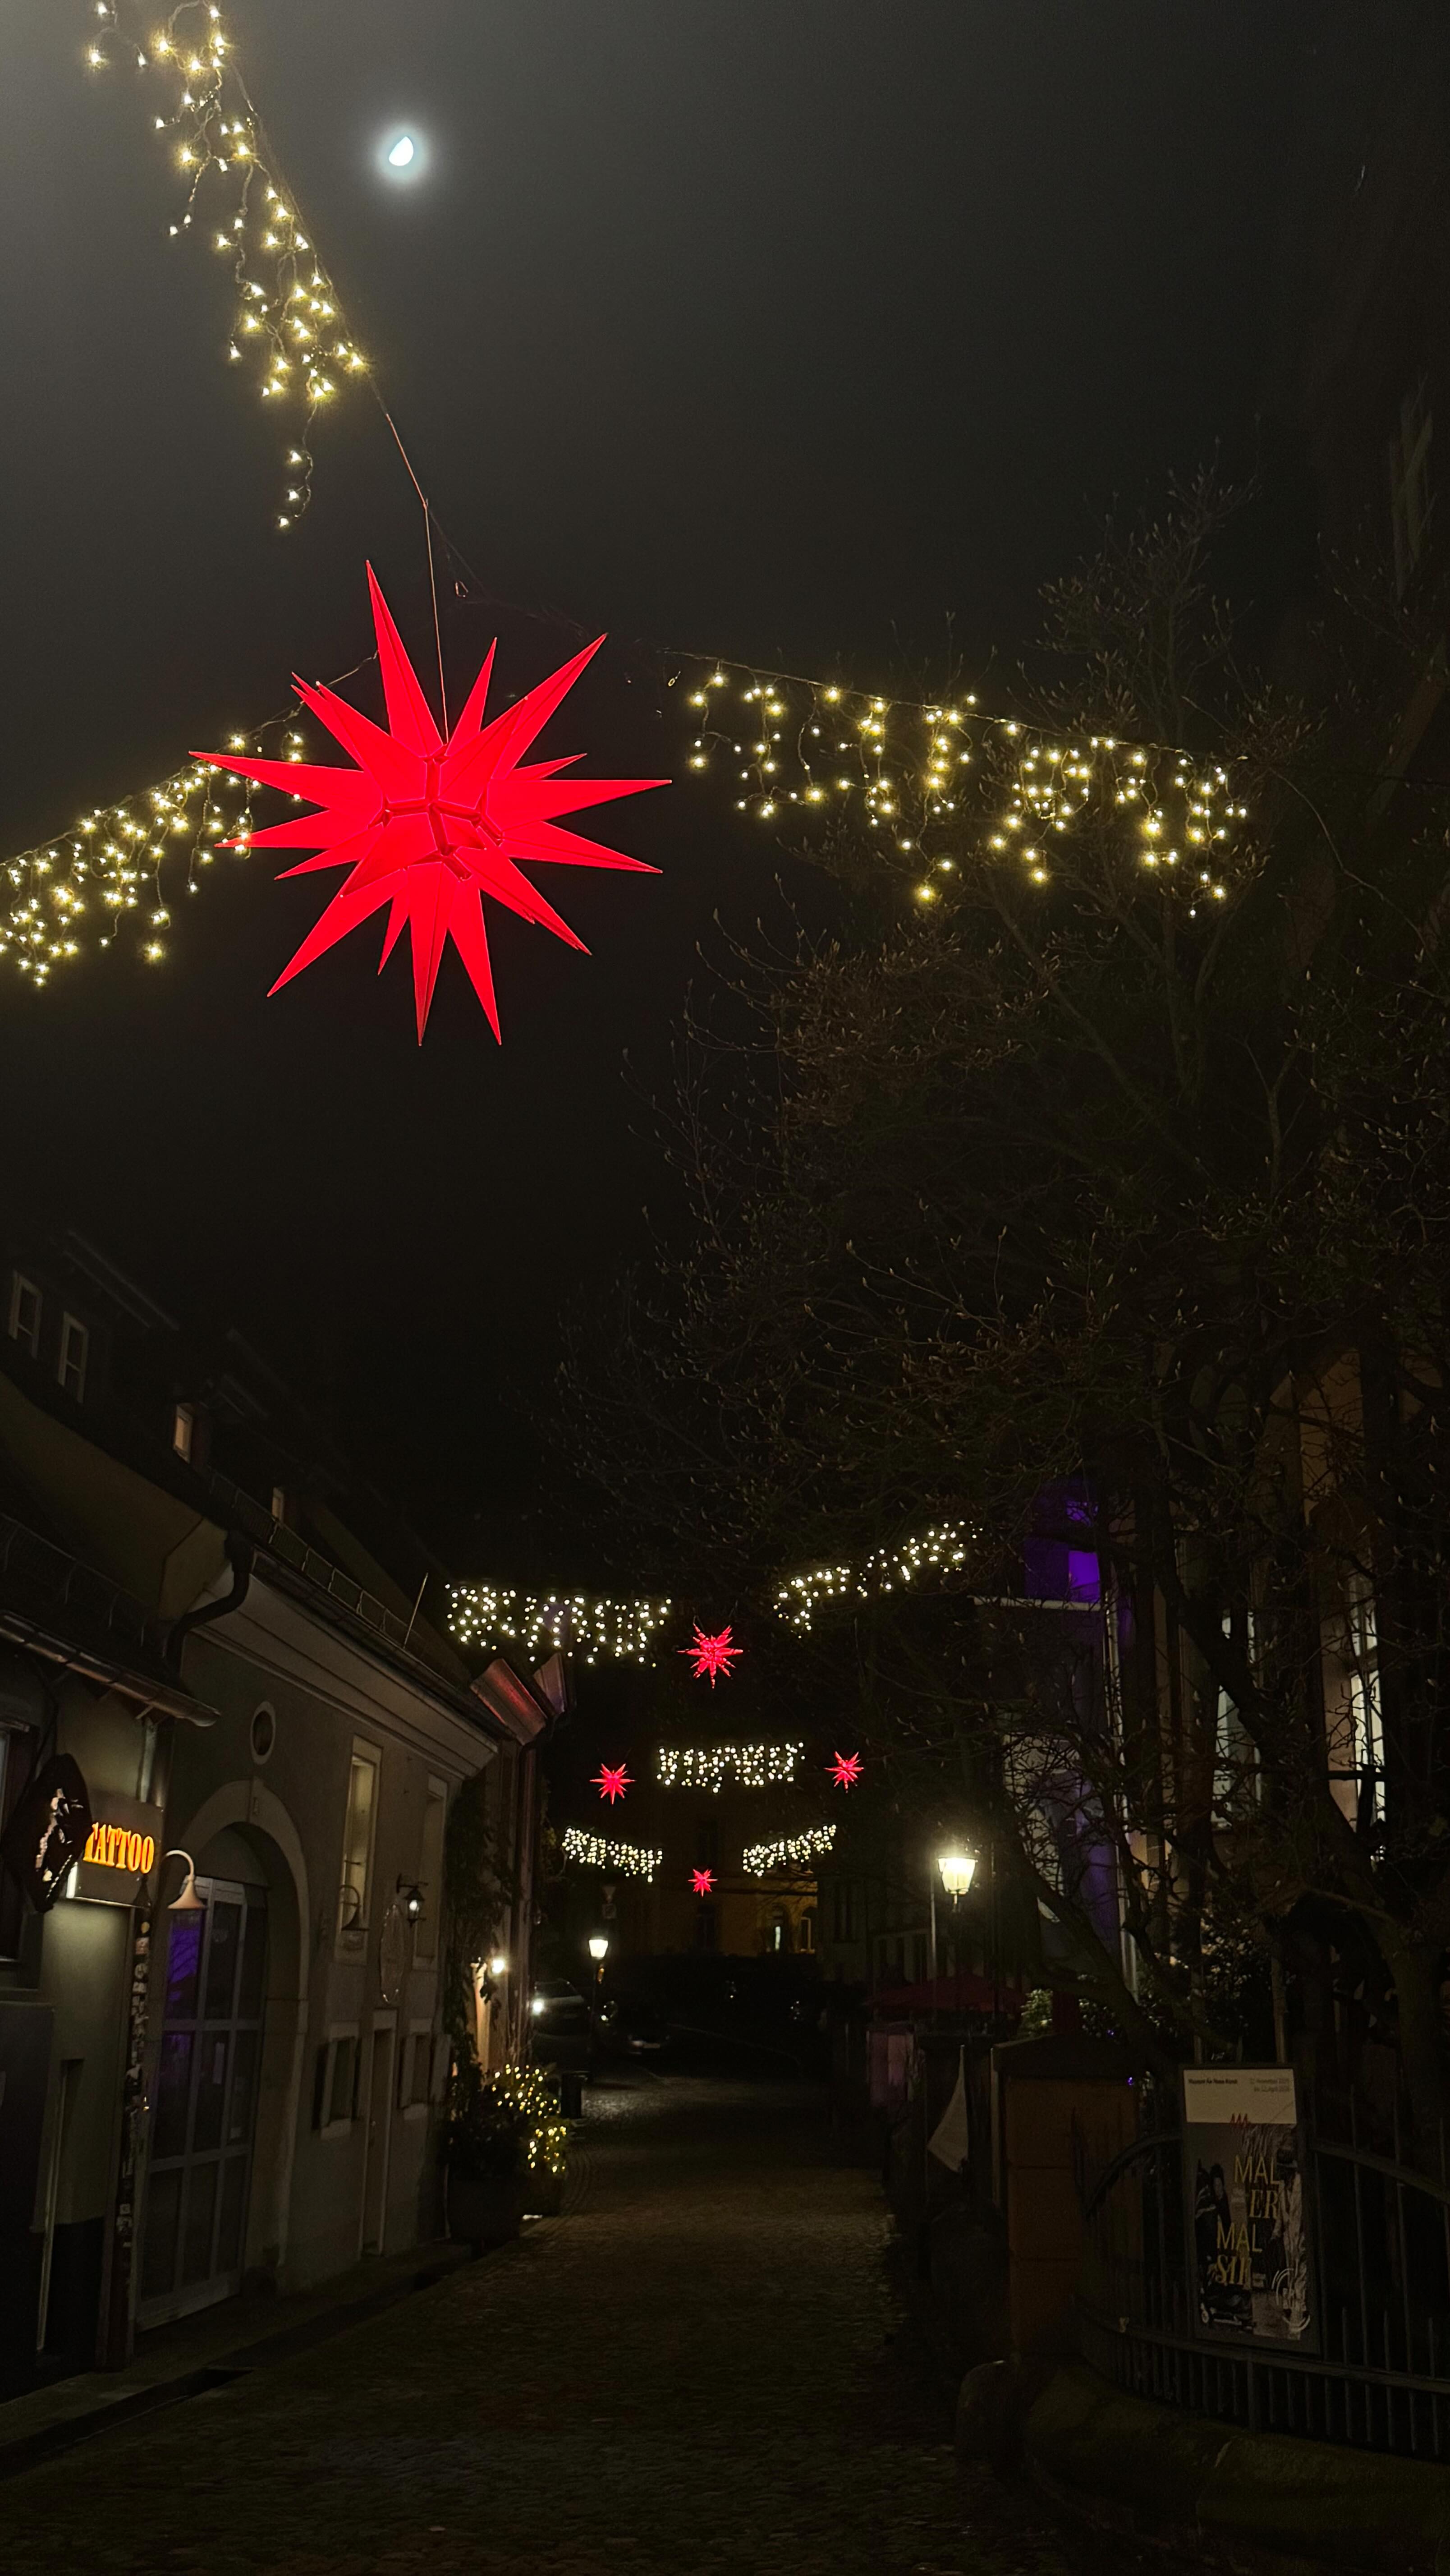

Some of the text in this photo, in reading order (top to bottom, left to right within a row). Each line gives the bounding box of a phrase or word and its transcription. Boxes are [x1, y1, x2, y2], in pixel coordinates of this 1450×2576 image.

[83, 1822, 155, 1874] TATTOO
[1234, 2155, 1280, 2185] MAL
[1248, 2189, 1280, 2219] ER
[1217, 2222, 1262, 2252] MAL
